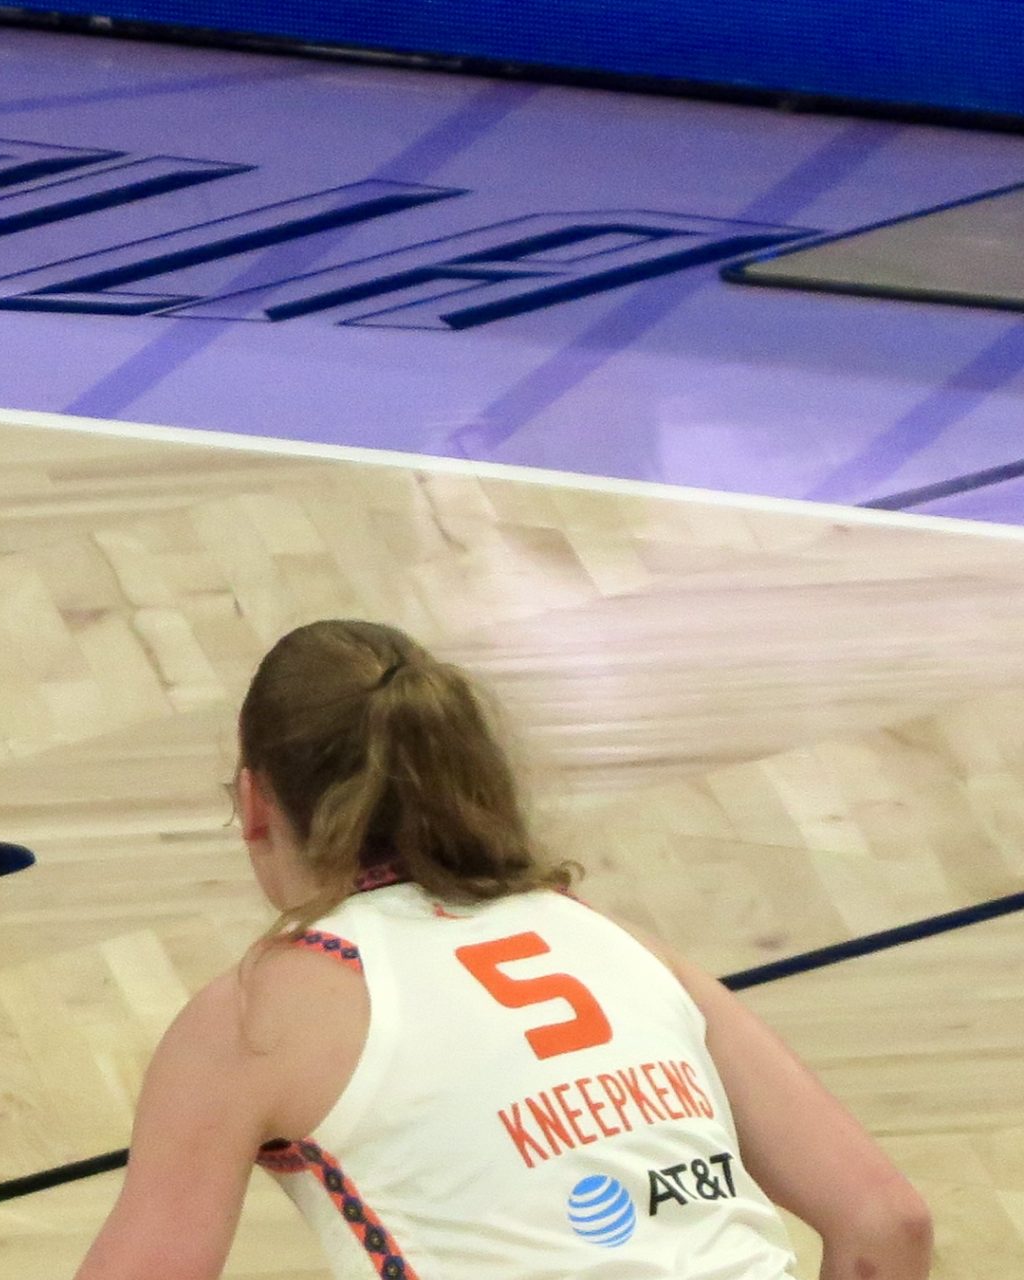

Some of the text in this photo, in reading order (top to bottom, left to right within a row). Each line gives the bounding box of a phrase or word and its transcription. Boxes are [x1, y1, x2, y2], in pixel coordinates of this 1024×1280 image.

[455, 930, 614, 1061] 5
[497, 1060, 715, 1169] KNEEPKENS
[648, 1152, 739, 1218] AT&T
